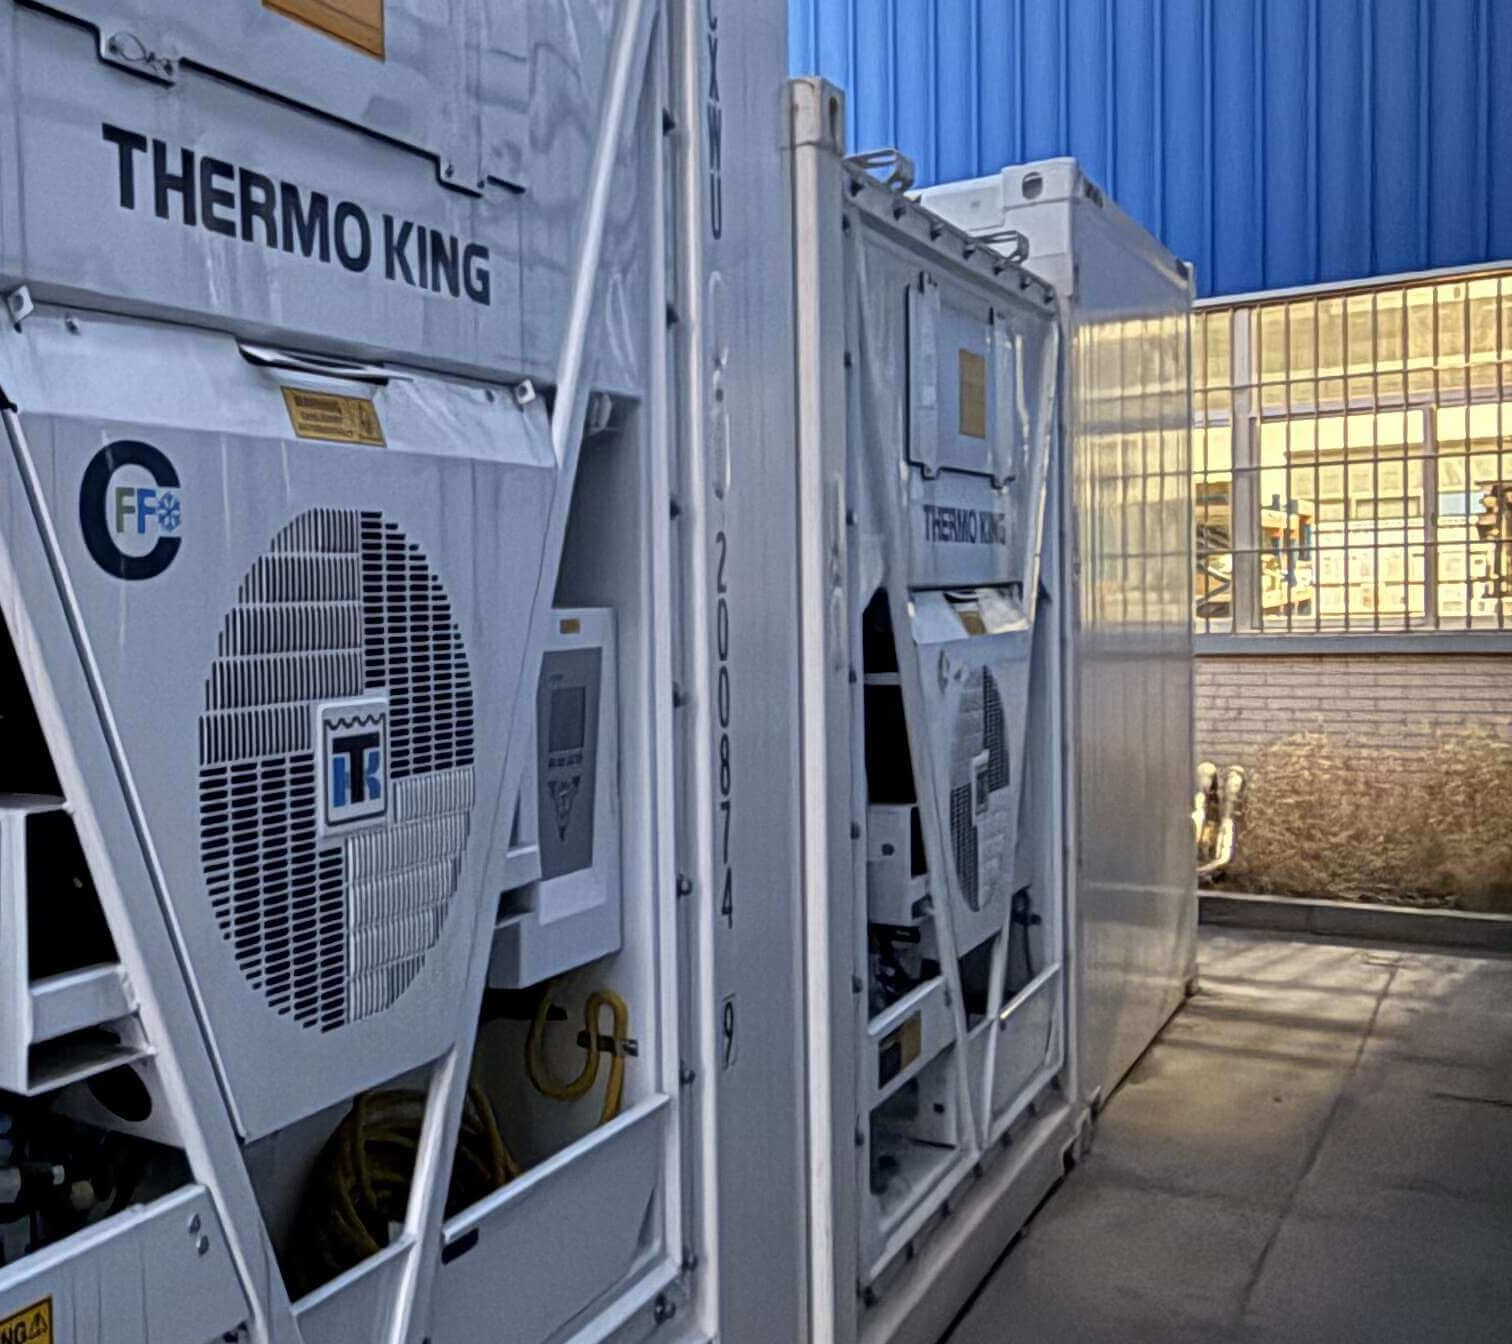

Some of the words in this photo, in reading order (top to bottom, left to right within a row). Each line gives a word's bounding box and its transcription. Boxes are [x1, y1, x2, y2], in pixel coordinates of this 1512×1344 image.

[101, 122, 373, 274] THERMO
[382, 213, 492, 307] KING
[922, 504, 978, 544] THERMO
[715, 530, 733, 929] 200874
[723, 1000, 734, 1067] 9
